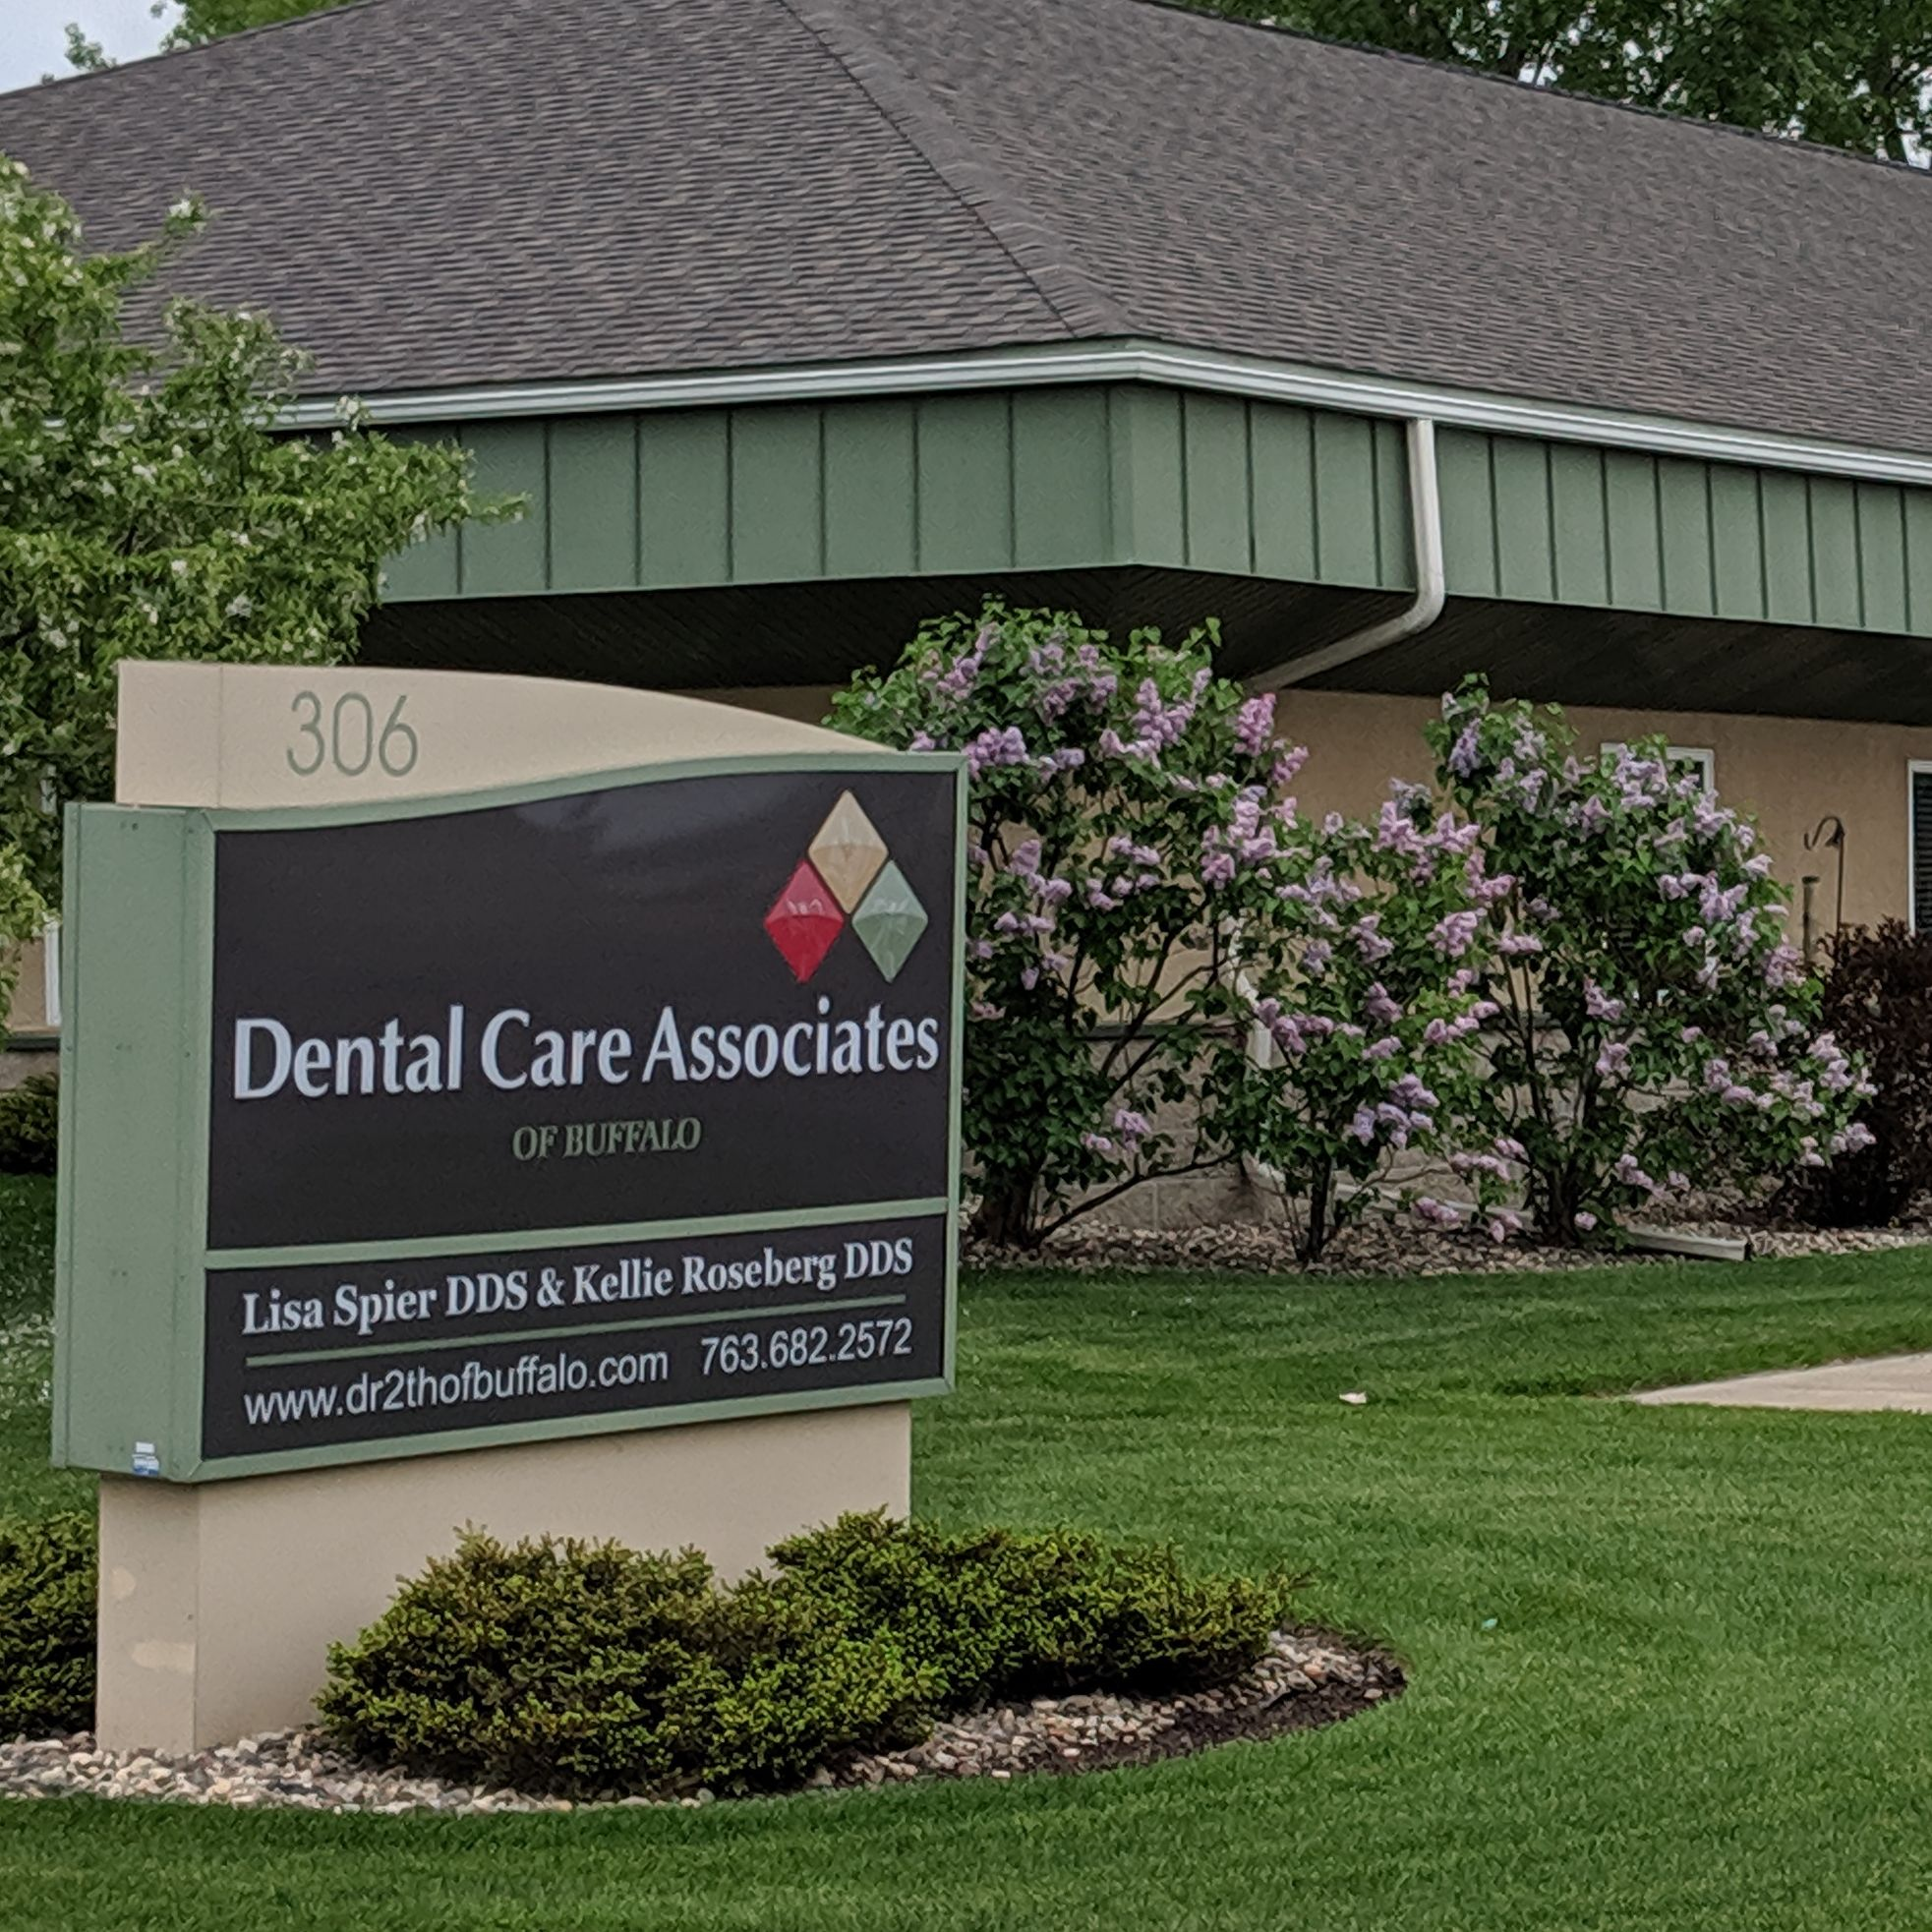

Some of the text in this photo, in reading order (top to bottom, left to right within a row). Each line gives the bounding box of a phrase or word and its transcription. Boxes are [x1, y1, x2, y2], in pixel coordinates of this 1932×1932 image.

[286, 690, 419, 777] 306
[233, 995, 940, 1099] Dental Care Associates
[512, 1117, 702, 1161] OF BUFFALO
[242, 1239, 914, 1335] Lisa Spier DDS & Kellie Roseberg DDS
[244, 1317, 913, 1426] www.dr2thofbuffalo.com 763.682.2572
